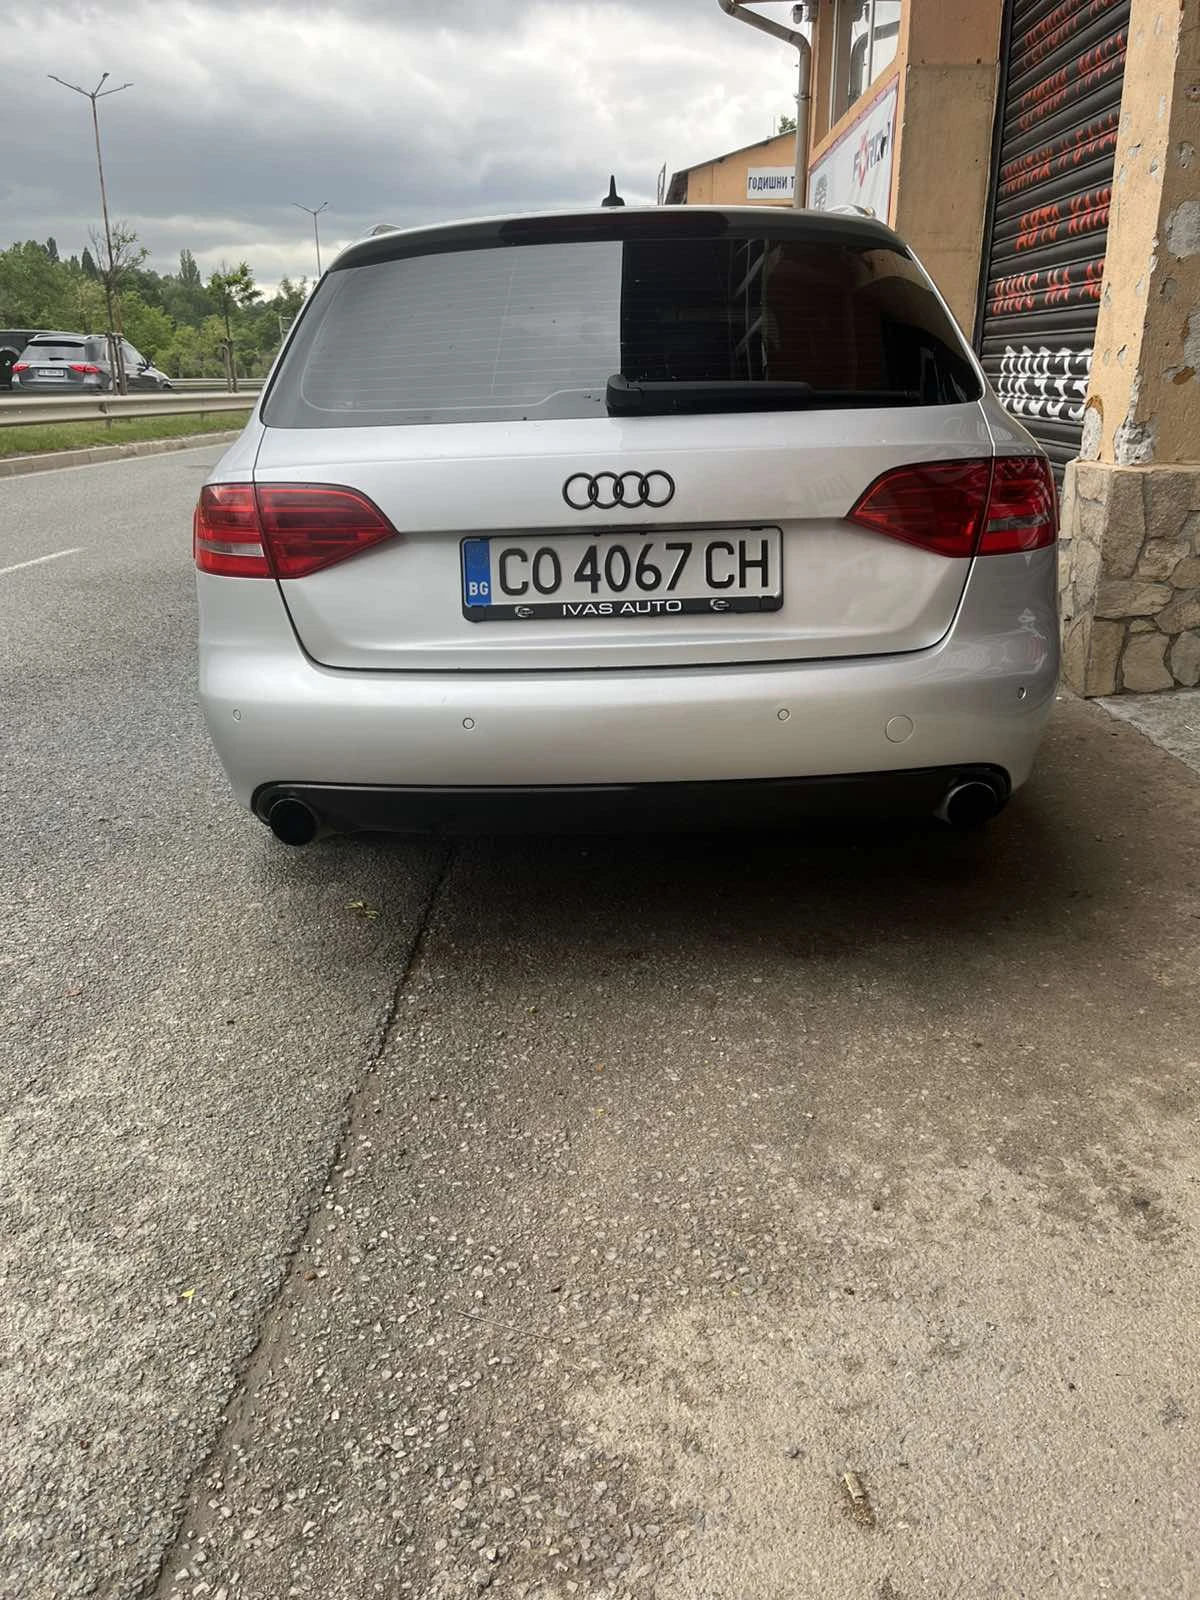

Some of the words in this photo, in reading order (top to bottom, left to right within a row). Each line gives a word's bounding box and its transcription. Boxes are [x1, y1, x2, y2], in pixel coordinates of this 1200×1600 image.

[747, 176, 788, 191] ГОДИШНИ
[1014, 203, 1060, 251] АВТО
[1043, 264, 1071, 305] НА
[573, 542, 693, 594] 4067
[705, 539, 768, 590] CH
[468, 581, 489, 596] BG
[562, 603, 613, 616] IVAS
[620, 600, 682, 614] AUTO
